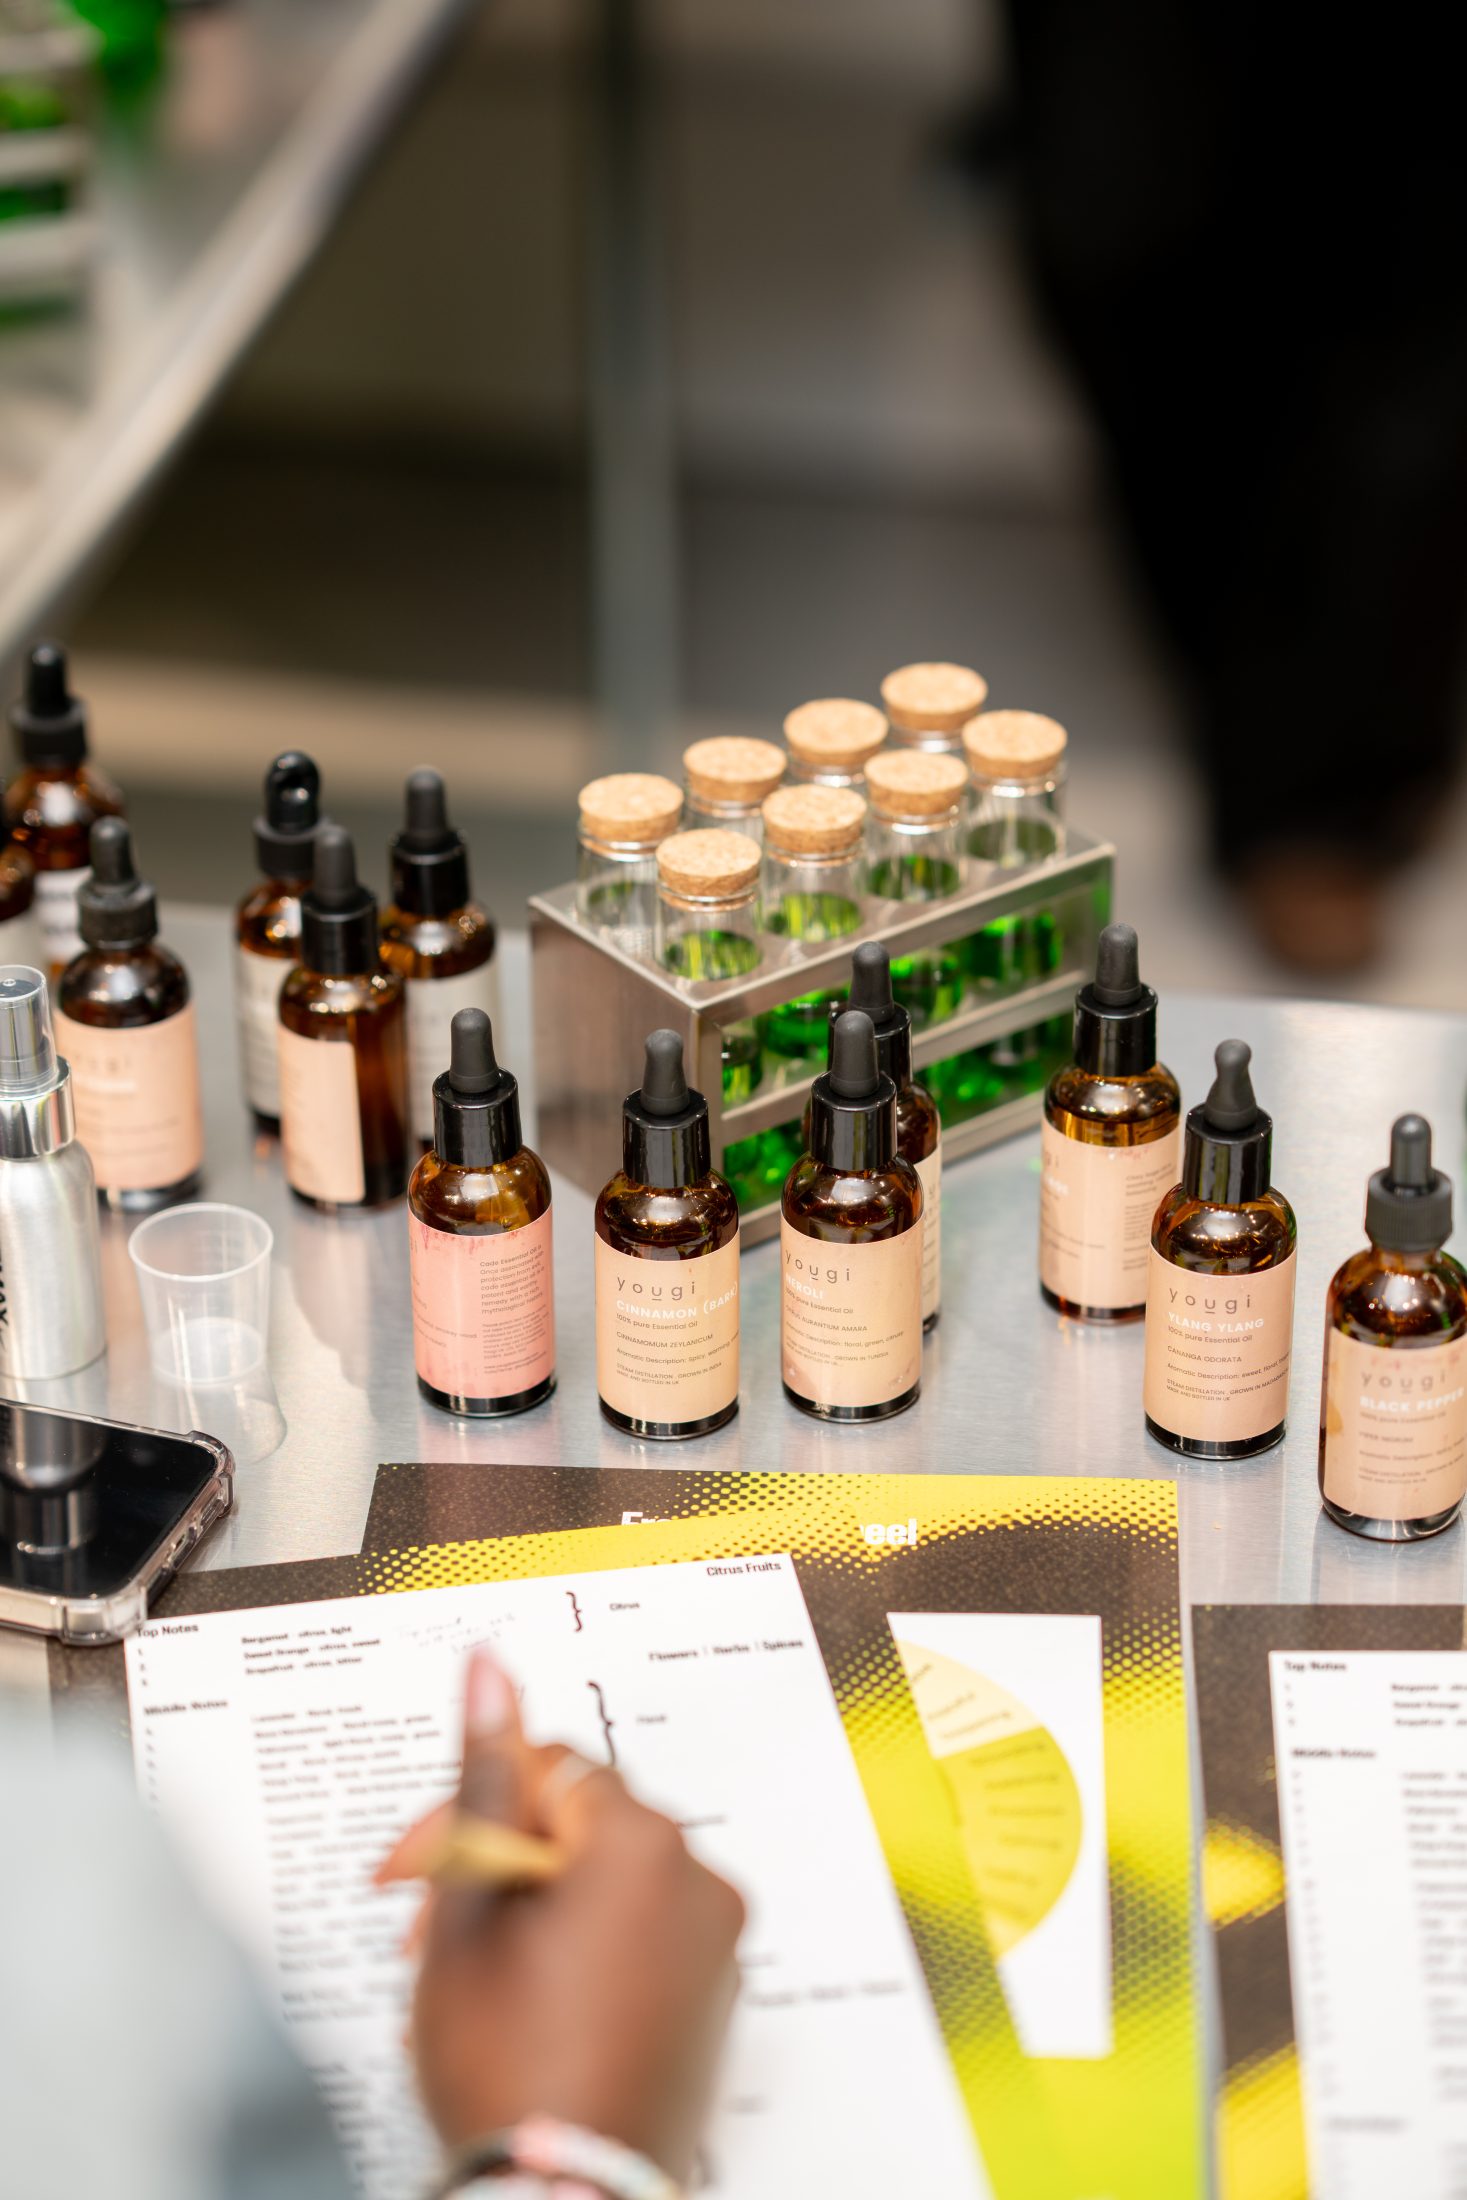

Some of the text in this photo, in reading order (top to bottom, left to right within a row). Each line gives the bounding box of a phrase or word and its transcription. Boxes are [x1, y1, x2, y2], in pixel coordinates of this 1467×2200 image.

[501, 1251, 529, 1265] Essential
[501, 1258, 534, 1273] associated
[785, 1249, 850, 1284] yougi
[480, 1274, 516, 1284] protection
[517, 1266, 531, 1276] from
[500, 1276, 529, 1289] essential
[481, 1291, 504, 1300] potent
[505, 1287, 519, 1295] and
[617, 1276, 696, 1301] yougi
[510, 1294, 523, 1302] with
[616, 1281, 738, 1320] CINNAMON (BARK)
[1169, 1287, 1251, 1315] yougi
[482, 1301, 526, 1315] mythological
[810, 1302, 842, 1314] Essential
[616, 1313, 632, 1325] 100%
[633, 1320, 650, 1330] pure
[688, 1320, 698, 1328] Oil
[801, 1316, 840, 1331] AURANTIUM
[1168, 1311, 1264, 1333] YLANG YLANG
[616, 1331, 668, 1348] CINNAMOMUM
[669, 1333, 714, 1348] ZEYLANICUM
[1168, 1325, 1254, 1344] 100% pure Essential Oil
[616, 1348, 644, 1362] Aromatic
[646, 1356, 687, 1366] Description:
[1167, 1345, 1202, 1362] CANANGA
[634, 1370, 673, 1380] DISTILLATION
[678, 1369, 702, 1379] GROWN
[1167, 1362, 1196, 1377] Aromatic
[1198, 1372, 1240, 1381] Description:
[1166, 1378, 1185, 1390] STEAM
[1185, 1385, 1225, 1395] DISTILLATION
[1230, 1386, 1254, 1395] GROWN
[1360, 1368, 1446, 1394] yougi
[1360, 1395, 1410, 1412] BLACK
[860, 1518, 918, 1546] eel
[706, 1561, 782, 1577] Citrus Fruits
[137, 1623, 199, 1638] Top Notes
